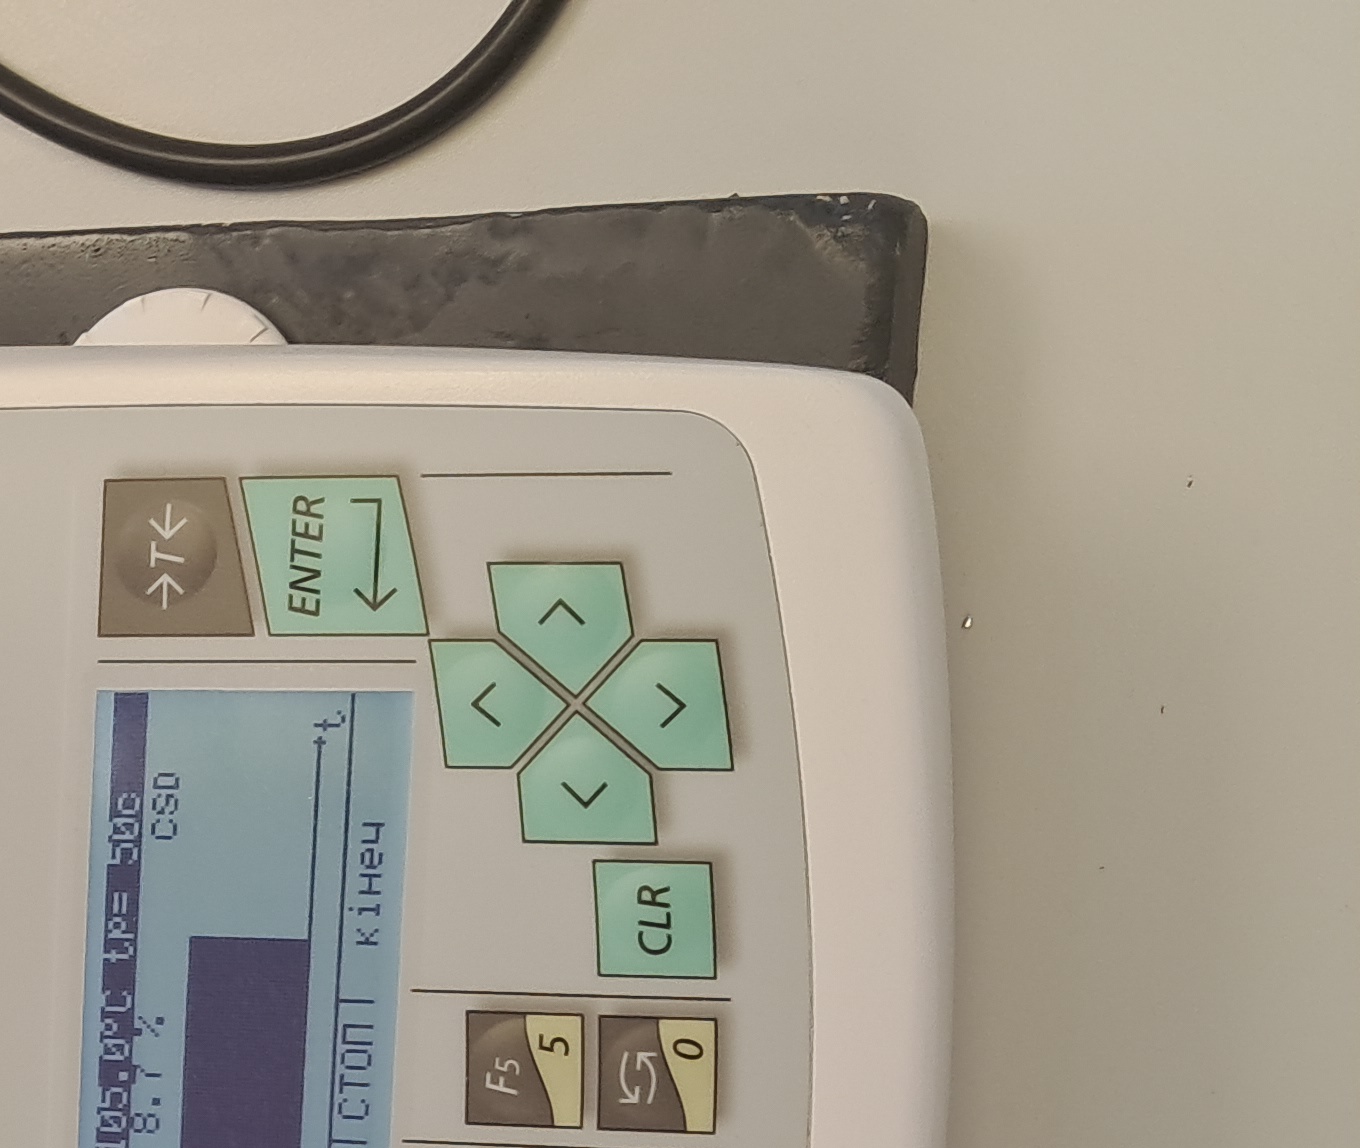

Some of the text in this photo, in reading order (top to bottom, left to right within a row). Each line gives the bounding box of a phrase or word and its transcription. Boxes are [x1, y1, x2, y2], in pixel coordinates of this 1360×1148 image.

[287, 494, 325, 618] ENTER
[150, 771, 180, 841] CSD
[636, 883, 672, 957] CLR
[336, 1023, 374, 1121] СТОП
[484, 1056, 521, 1097] F5
[537, 1033, 570, 1058] 5
[671, 1038, 704, 1061] 0
